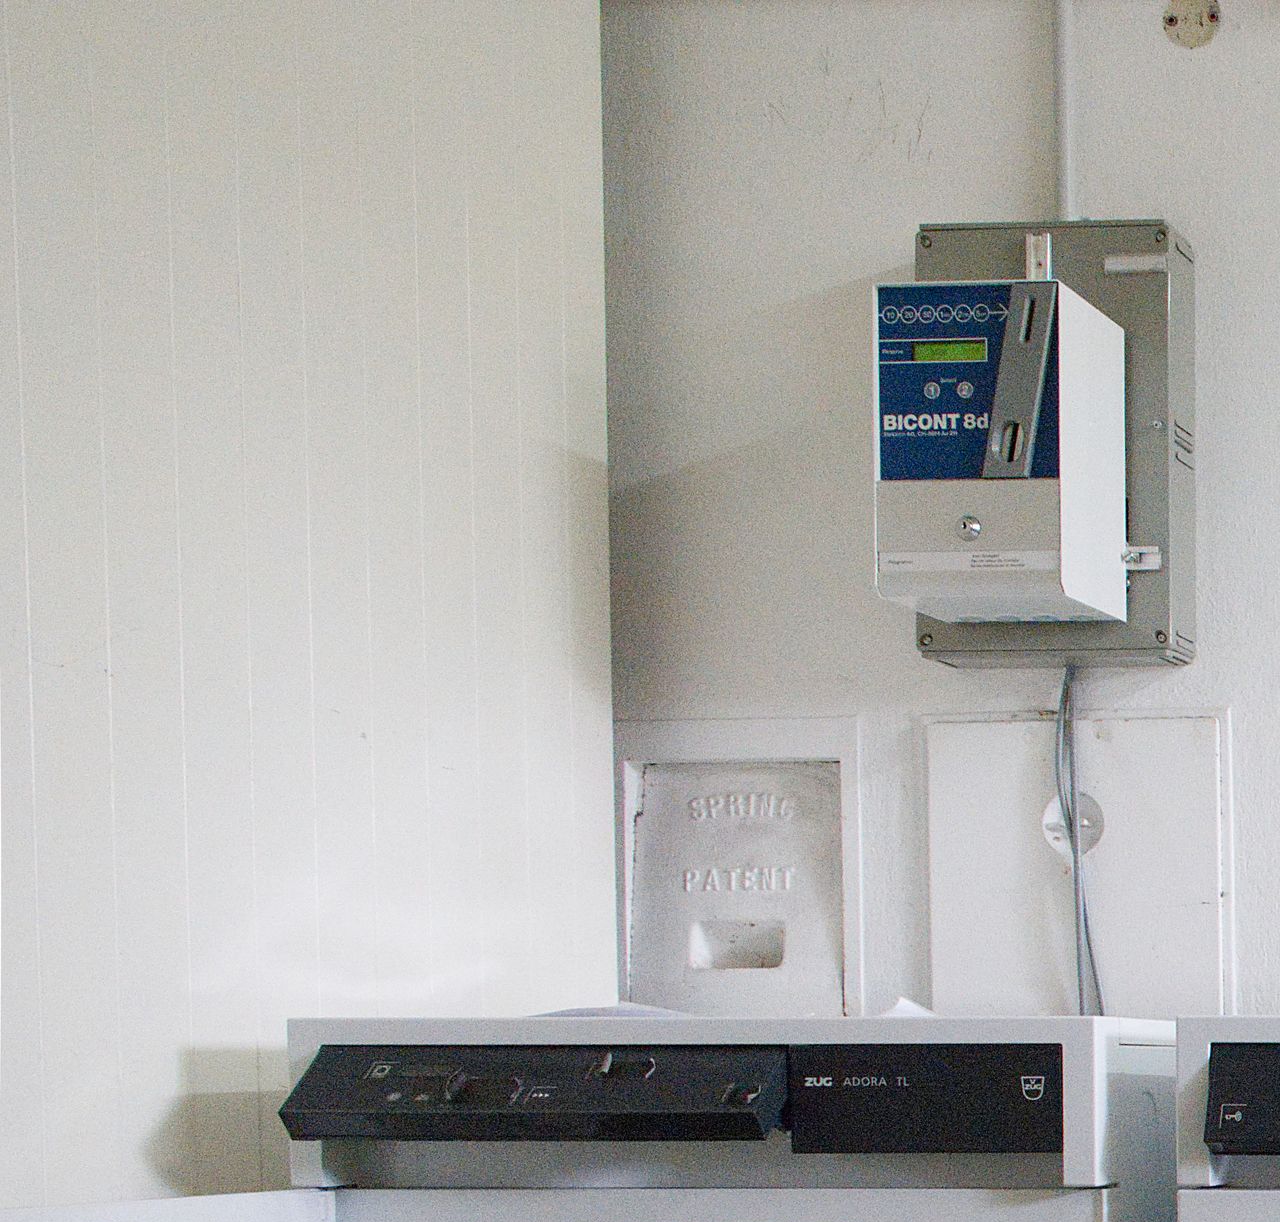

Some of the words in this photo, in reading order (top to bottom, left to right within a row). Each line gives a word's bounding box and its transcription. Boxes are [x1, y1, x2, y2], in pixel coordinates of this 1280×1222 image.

[883, 413, 960, 431] BICONT
[963, 412, 989, 430] 8d
[682, 866, 796, 892] PATENT
[804, 1076, 833, 1087] ZUG
[843, 1076, 887, 1087] ADORA
[896, 1076, 910, 1087] TL
